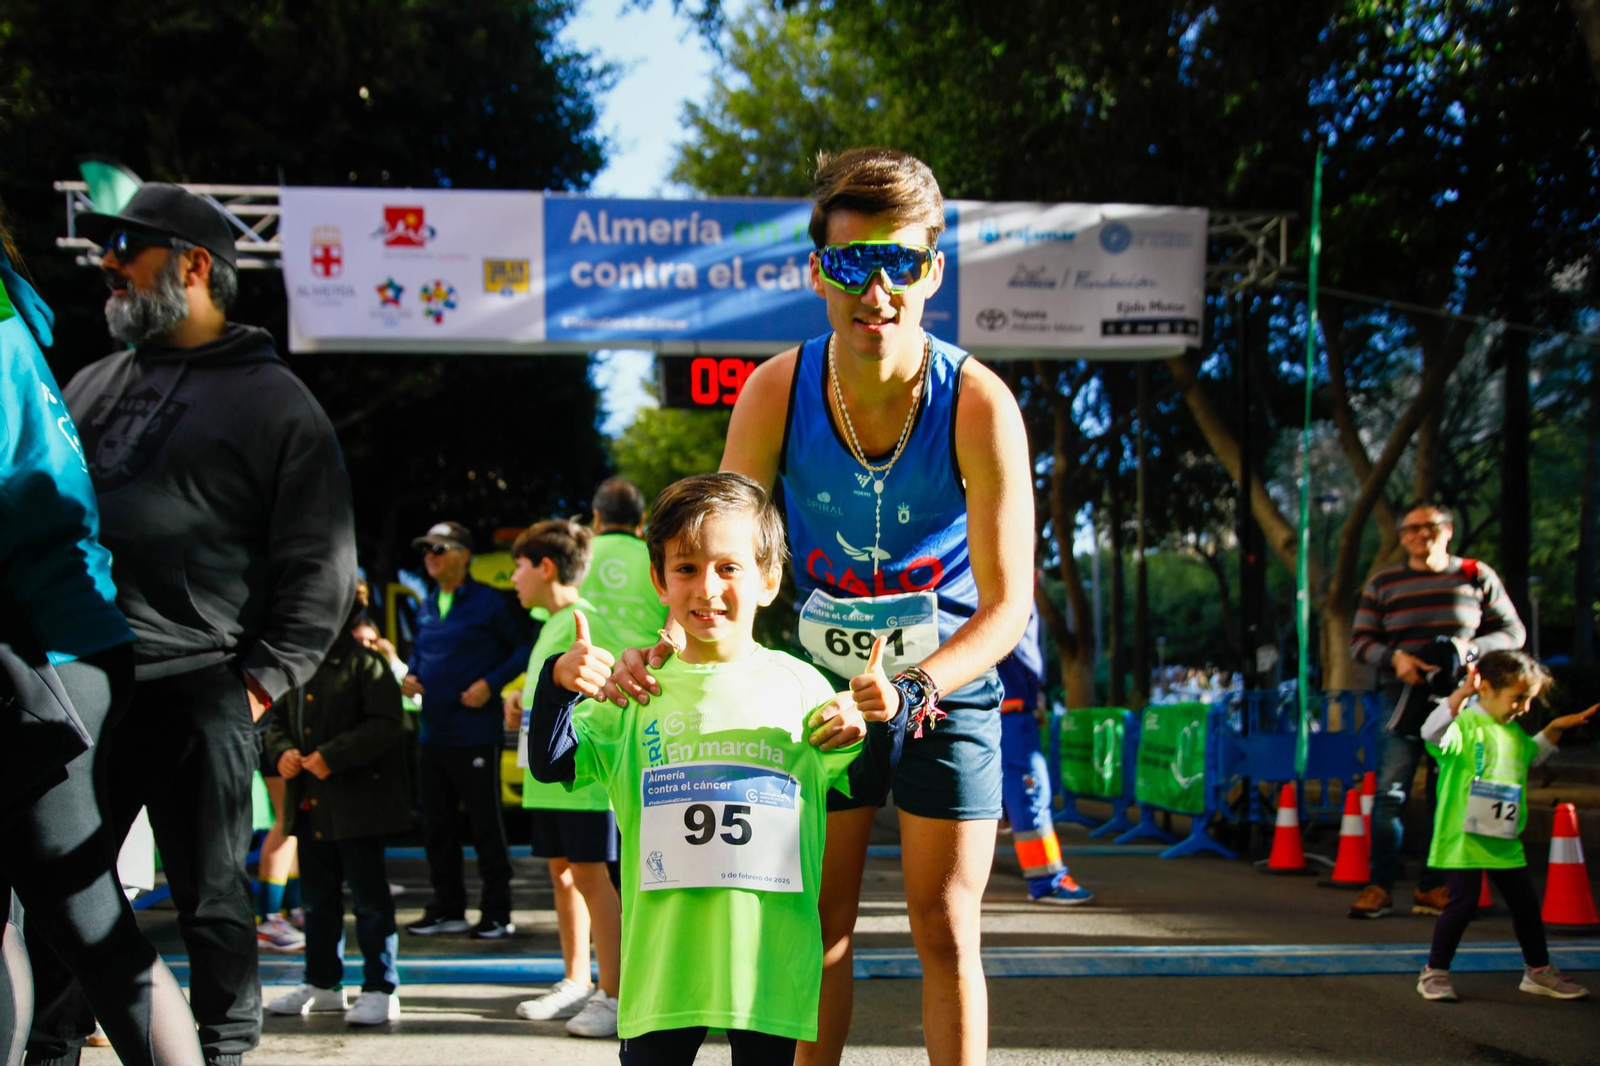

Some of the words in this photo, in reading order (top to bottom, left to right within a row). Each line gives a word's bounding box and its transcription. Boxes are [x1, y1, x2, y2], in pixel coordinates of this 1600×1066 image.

[570, 210, 723, 244] Almería
[733, 220, 779, 244] en
[570, 257, 697, 289] contra
[708, 256, 746, 289] el
[1012, 308, 1048, 320] Toyota
[1149, 300, 1186, 313] Motor
[806, 498, 844, 516] SPIRAL
[806, 547, 944, 598] GALO
[825, 628, 904, 660] 691
[665, 742, 692, 764] En
[699, 739, 784, 765] marcha
[648, 770, 686, 783] Almería
[648, 783, 679, 795] contra
[681, 781, 691, 791] el
[693, 780, 732, 790] cáncer
[1491, 801, 1517, 821] 12
[684, 803, 753, 846] 95
[738, 872, 763, 881] febrero
[774, 877, 791, 885] 2025
